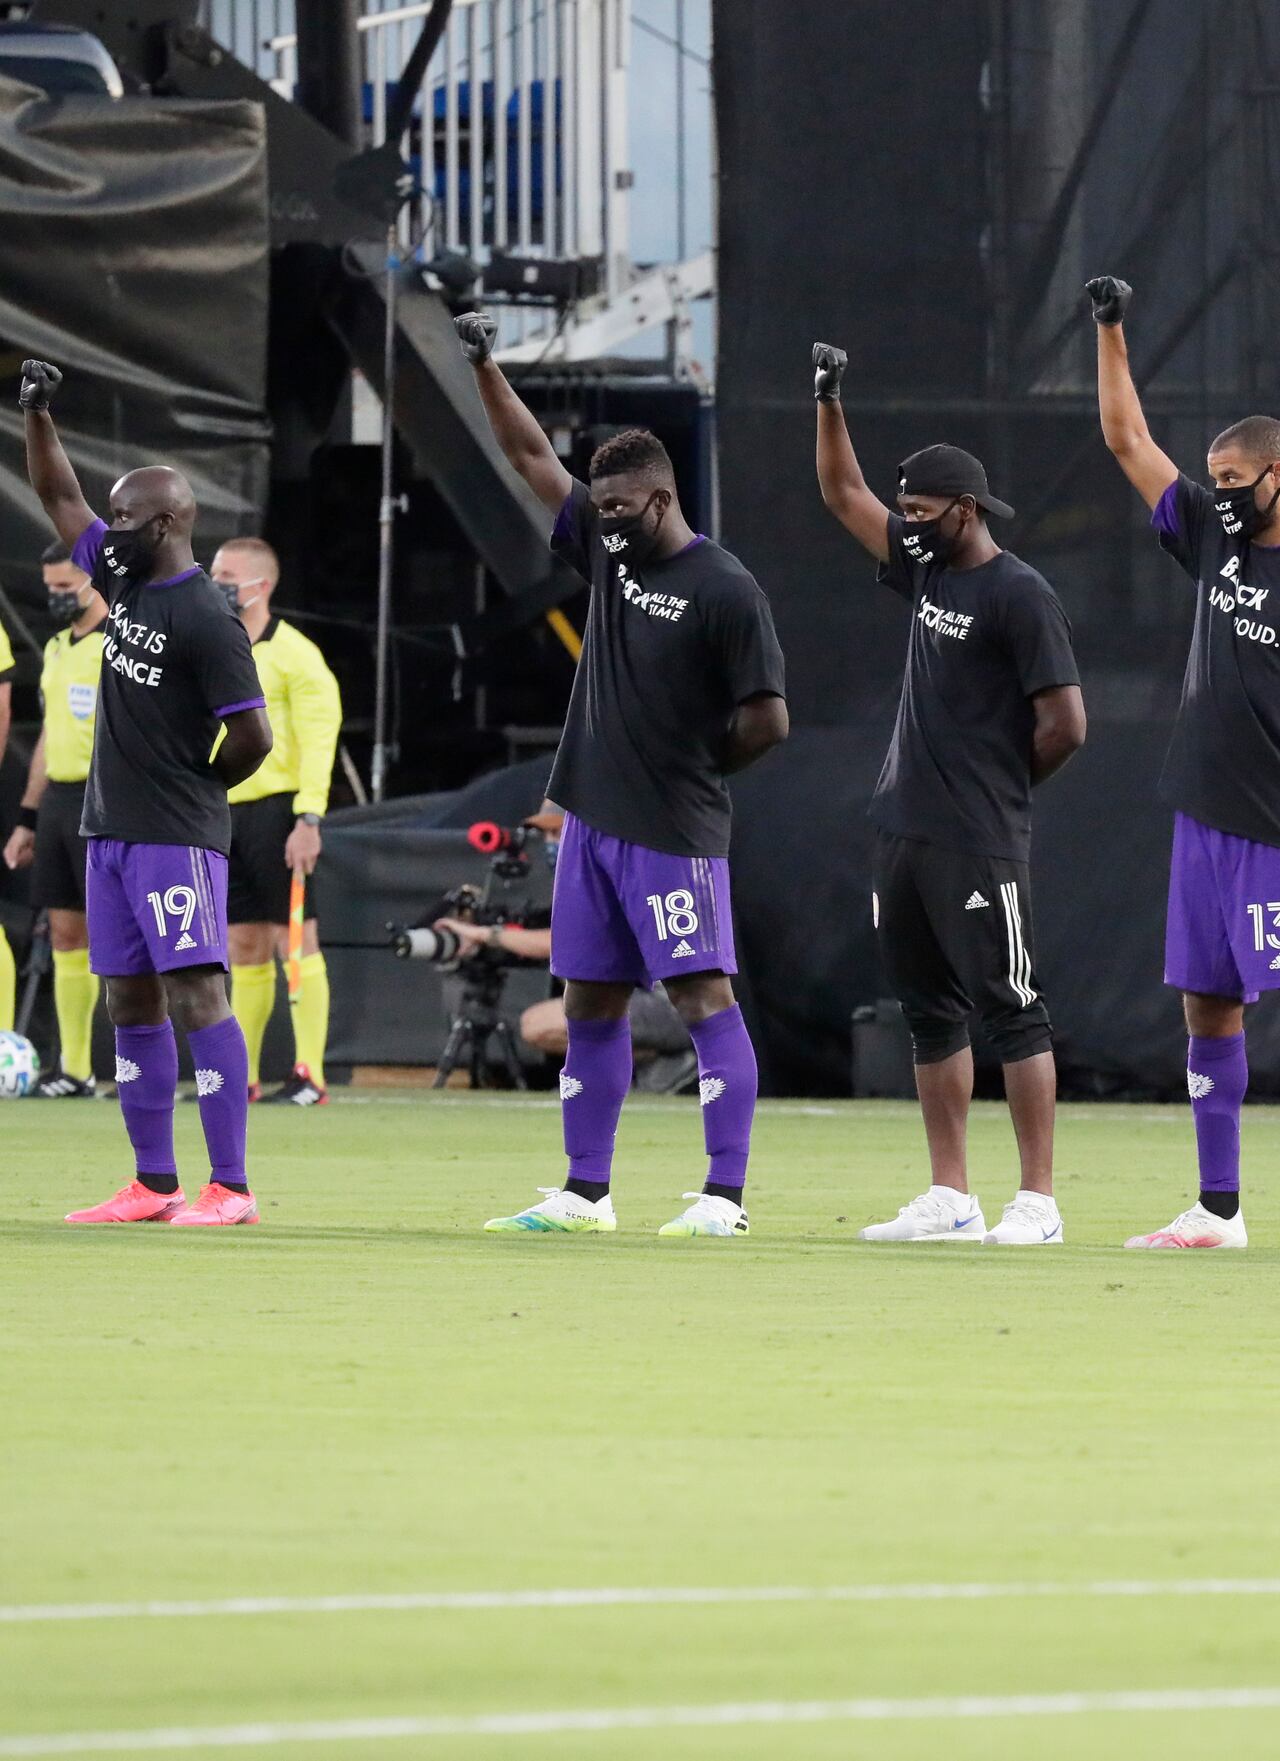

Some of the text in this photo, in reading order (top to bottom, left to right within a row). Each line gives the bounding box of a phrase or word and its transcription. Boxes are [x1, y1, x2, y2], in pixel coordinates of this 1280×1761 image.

[1215, 500, 1232, 511] ACK
[903, 535, 919, 546] ACK
[1220, 555, 1269, 611] BCK
[649, 592, 689, 610] ALL THE
[649, 604, 682, 621] TIME
[954, 613, 974, 627] THE
[938, 622, 969, 640] TIME
[143, 628, 168, 654] IS
[146, 885, 197, 938] 19
[965, 900, 990, 910] adidas
[646, 889, 699, 941] 18
[174, 941, 198, 951] adidas
[671, 949, 696, 959] adidas
